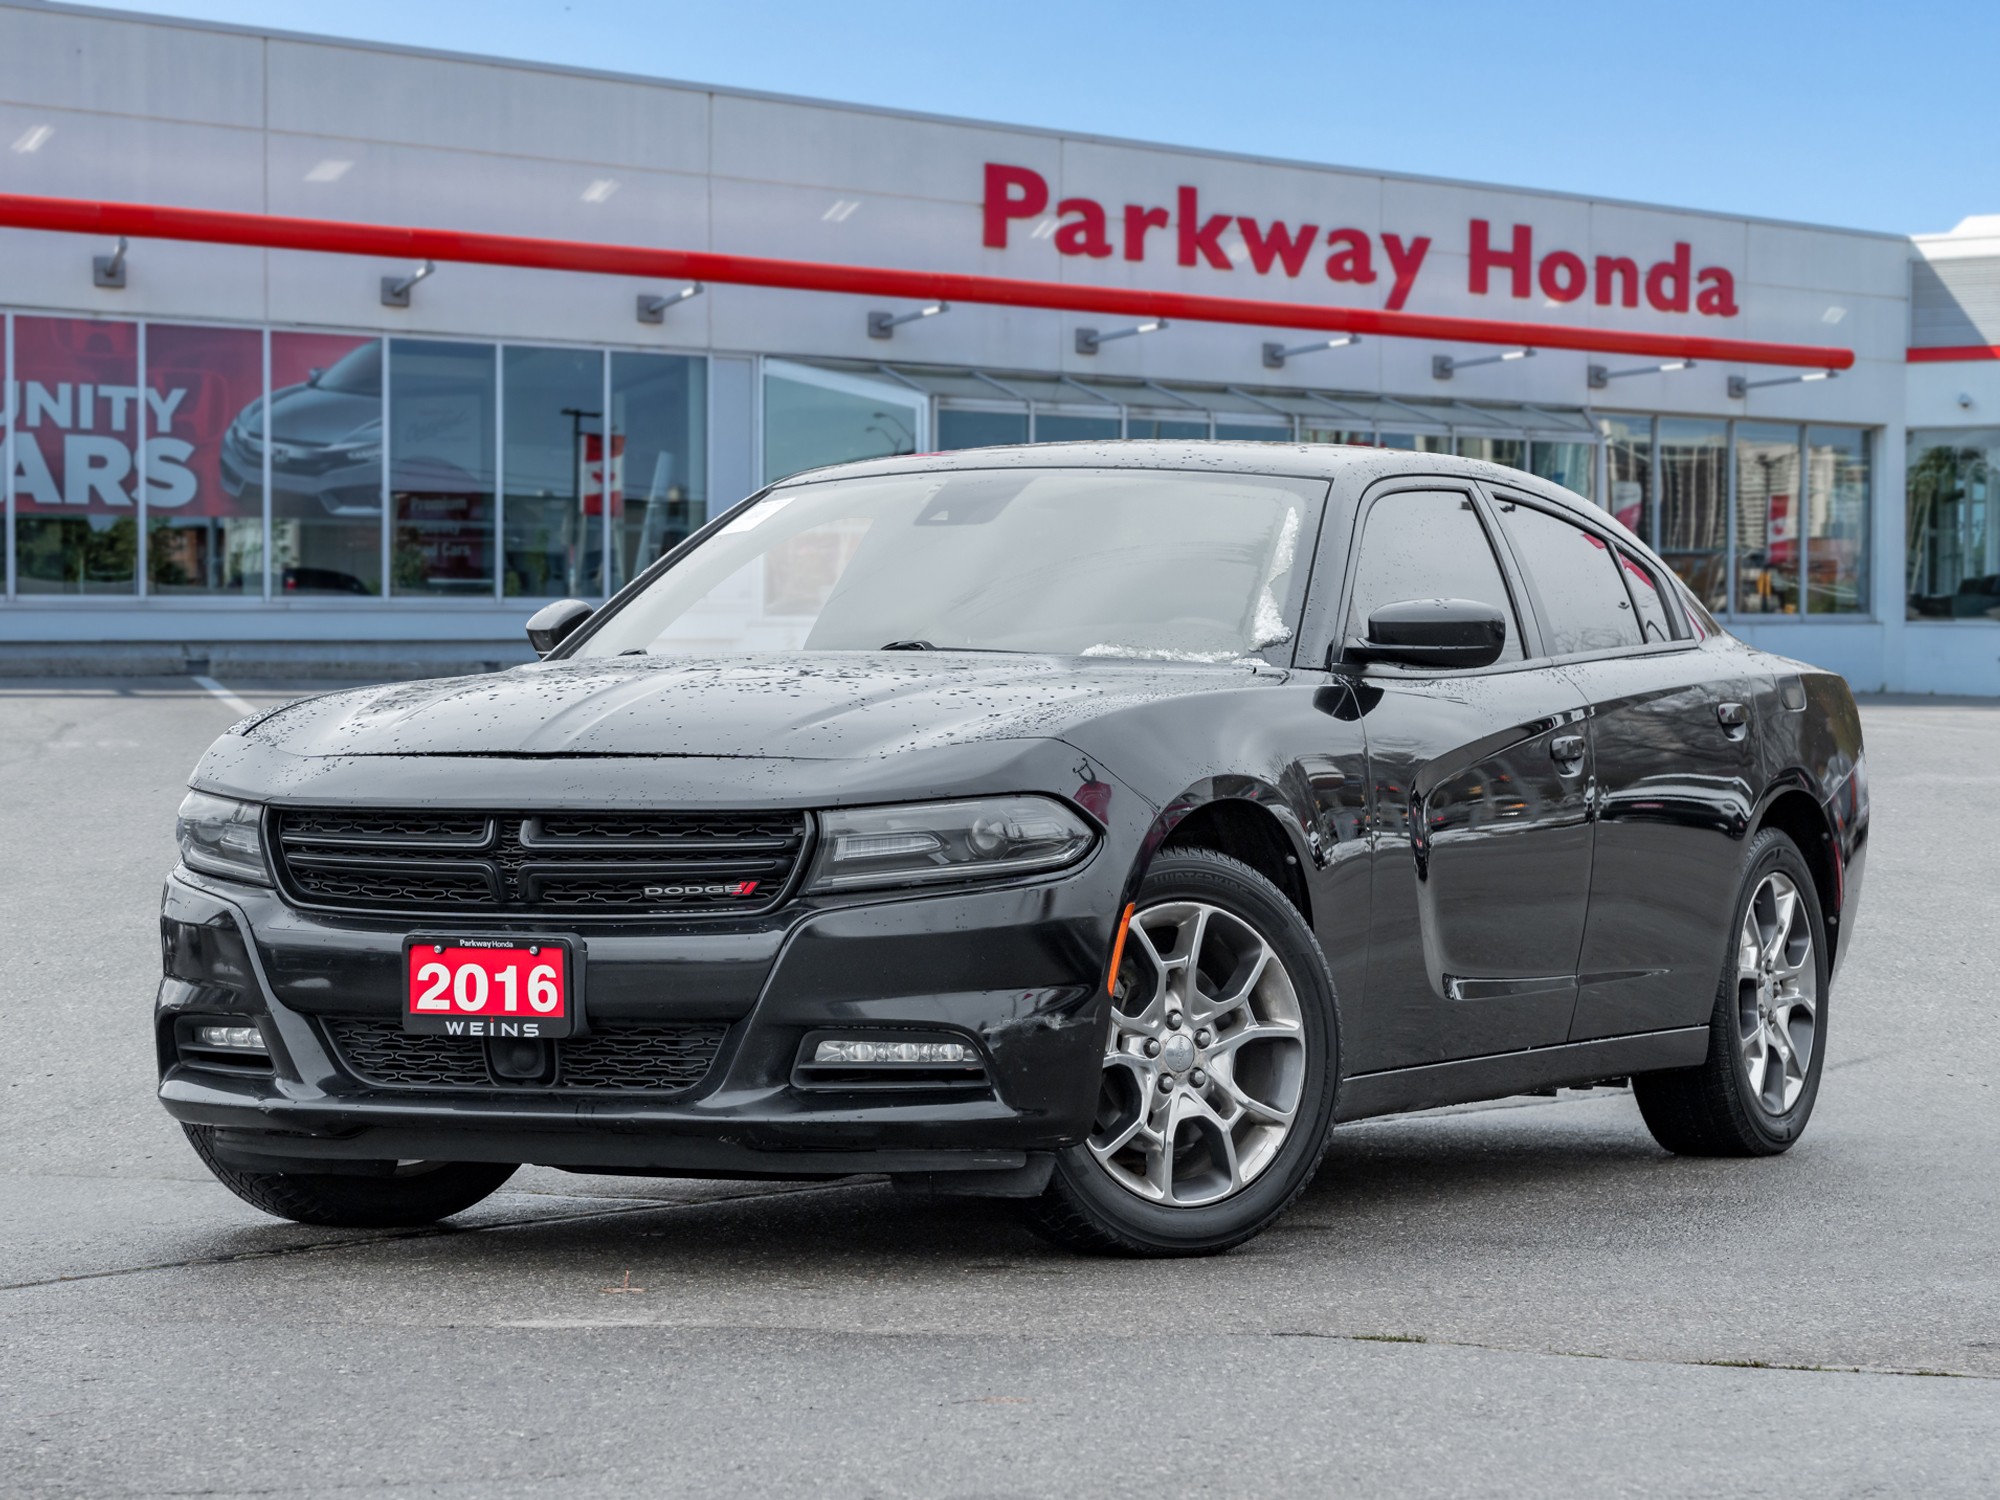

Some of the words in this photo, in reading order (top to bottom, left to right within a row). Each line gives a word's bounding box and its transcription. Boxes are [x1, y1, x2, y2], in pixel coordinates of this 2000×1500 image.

[983, 162, 1431, 310] Parkway
[1468, 218, 1739, 318] Honda
[644, 885, 742, 896] DODGE
[416, 962, 558, 1013] 2016
